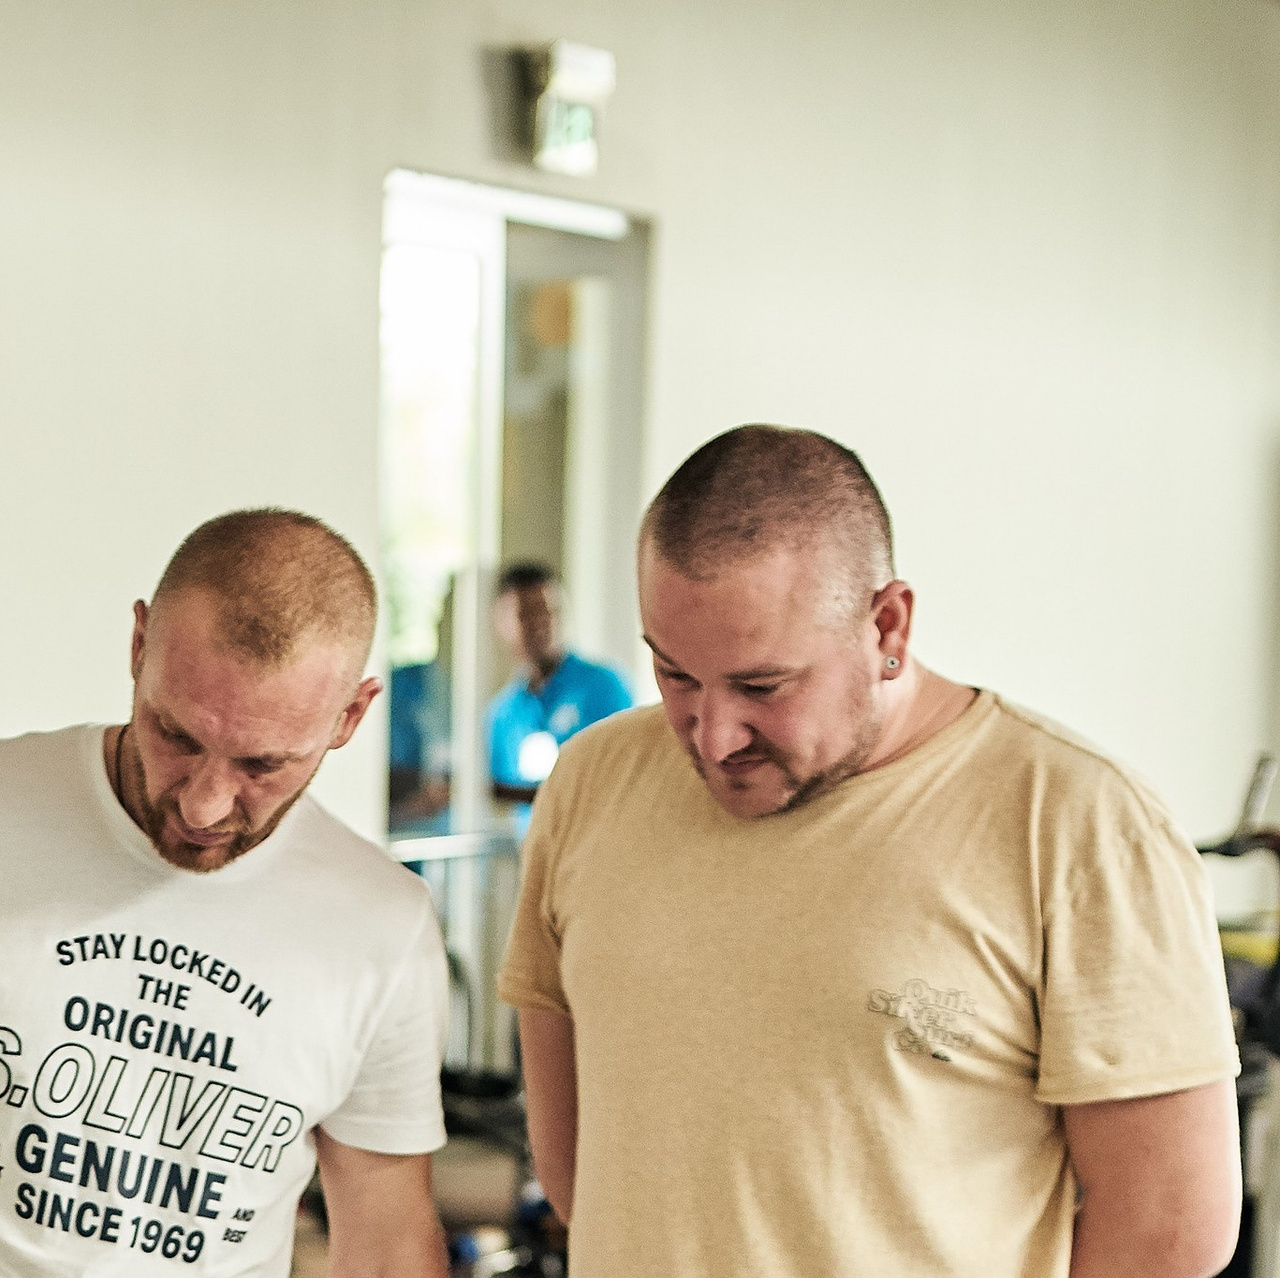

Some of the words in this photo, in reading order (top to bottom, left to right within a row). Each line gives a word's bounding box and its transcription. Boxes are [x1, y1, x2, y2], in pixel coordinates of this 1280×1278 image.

[56, 933, 127, 966] STAY
[133, 936, 240, 994] LOCKED
[239, 984, 272, 1017] IN
[138, 974, 191, 1011] THE
[64, 995, 238, 1072] ORIGINAL
[15, 1124, 227, 1219] GENUINE
[14, 1182, 122, 1243] SINCE
[129, 1215, 205, 1263] 1969
[222, 1227, 248, 1243] BEST
[231, 1207, 255, 1222] AND
